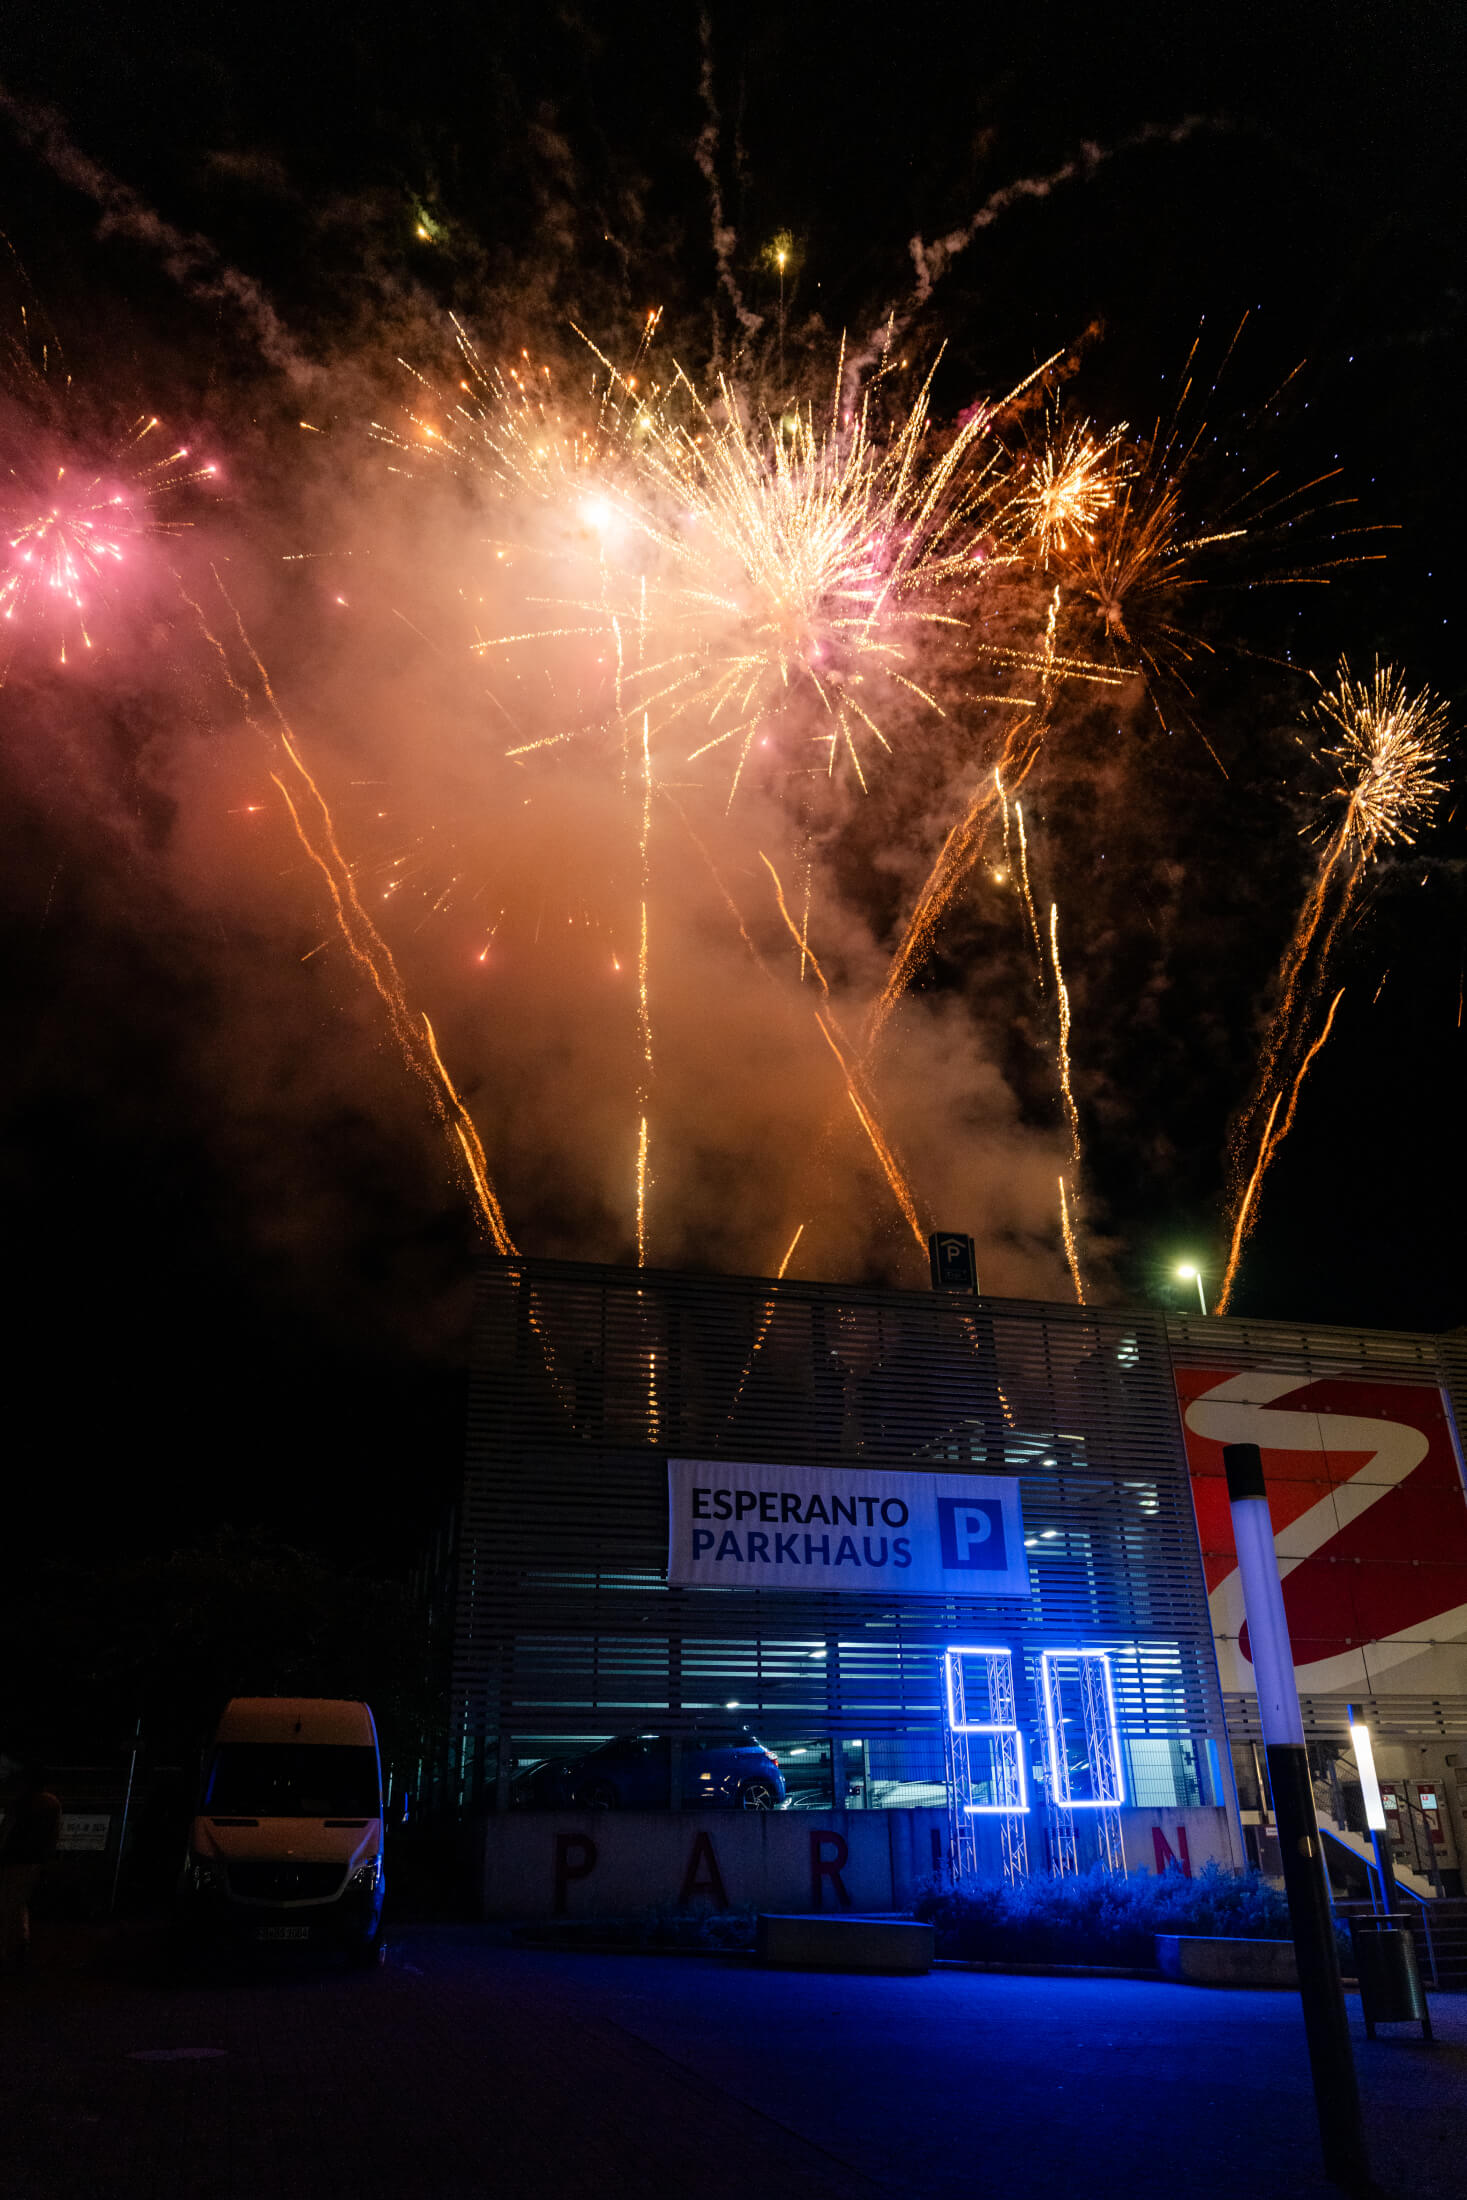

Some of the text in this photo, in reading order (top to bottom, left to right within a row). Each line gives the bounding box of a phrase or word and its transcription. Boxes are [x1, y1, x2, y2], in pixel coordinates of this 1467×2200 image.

[947, 1246, 960, 1263] P
[692, 1488, 909, 1528] ESPERANTO
[692, 1529, 913, 1568] PARKHAUS
[953, 1507, 992, 1561] P
